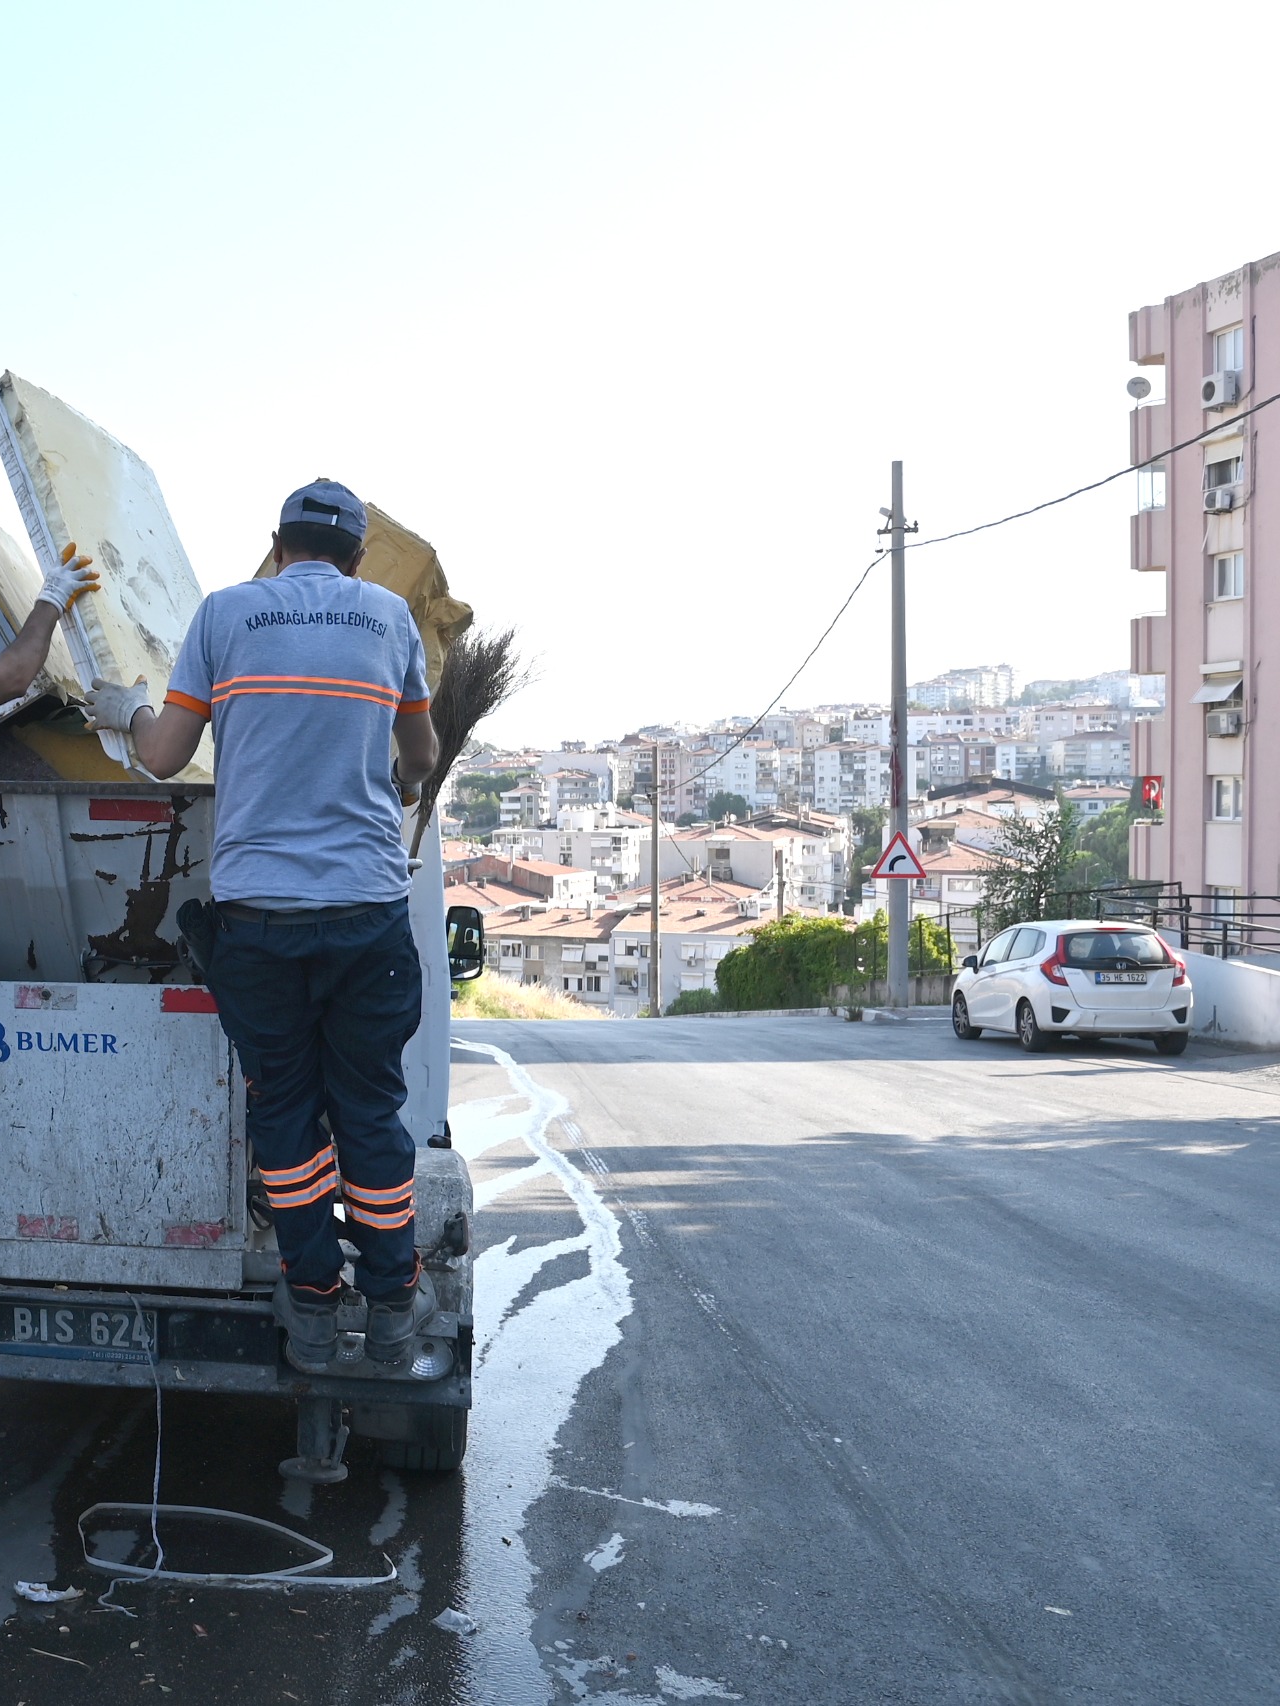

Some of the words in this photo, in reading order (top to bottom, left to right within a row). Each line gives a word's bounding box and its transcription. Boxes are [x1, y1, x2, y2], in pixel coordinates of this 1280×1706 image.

[245, 609, 323, 632] KARABAĞLAR
[326, 611, 388, 639] BELEDİYESİ
[1101, 973, 1111, 982] 35
[1126, 973, 1145, 982] 1622
[16, 1031, 118, 1054] BUMER
[13, 1307, 74, 1343] BIS
[90, 1312, 150, 1349] 624
